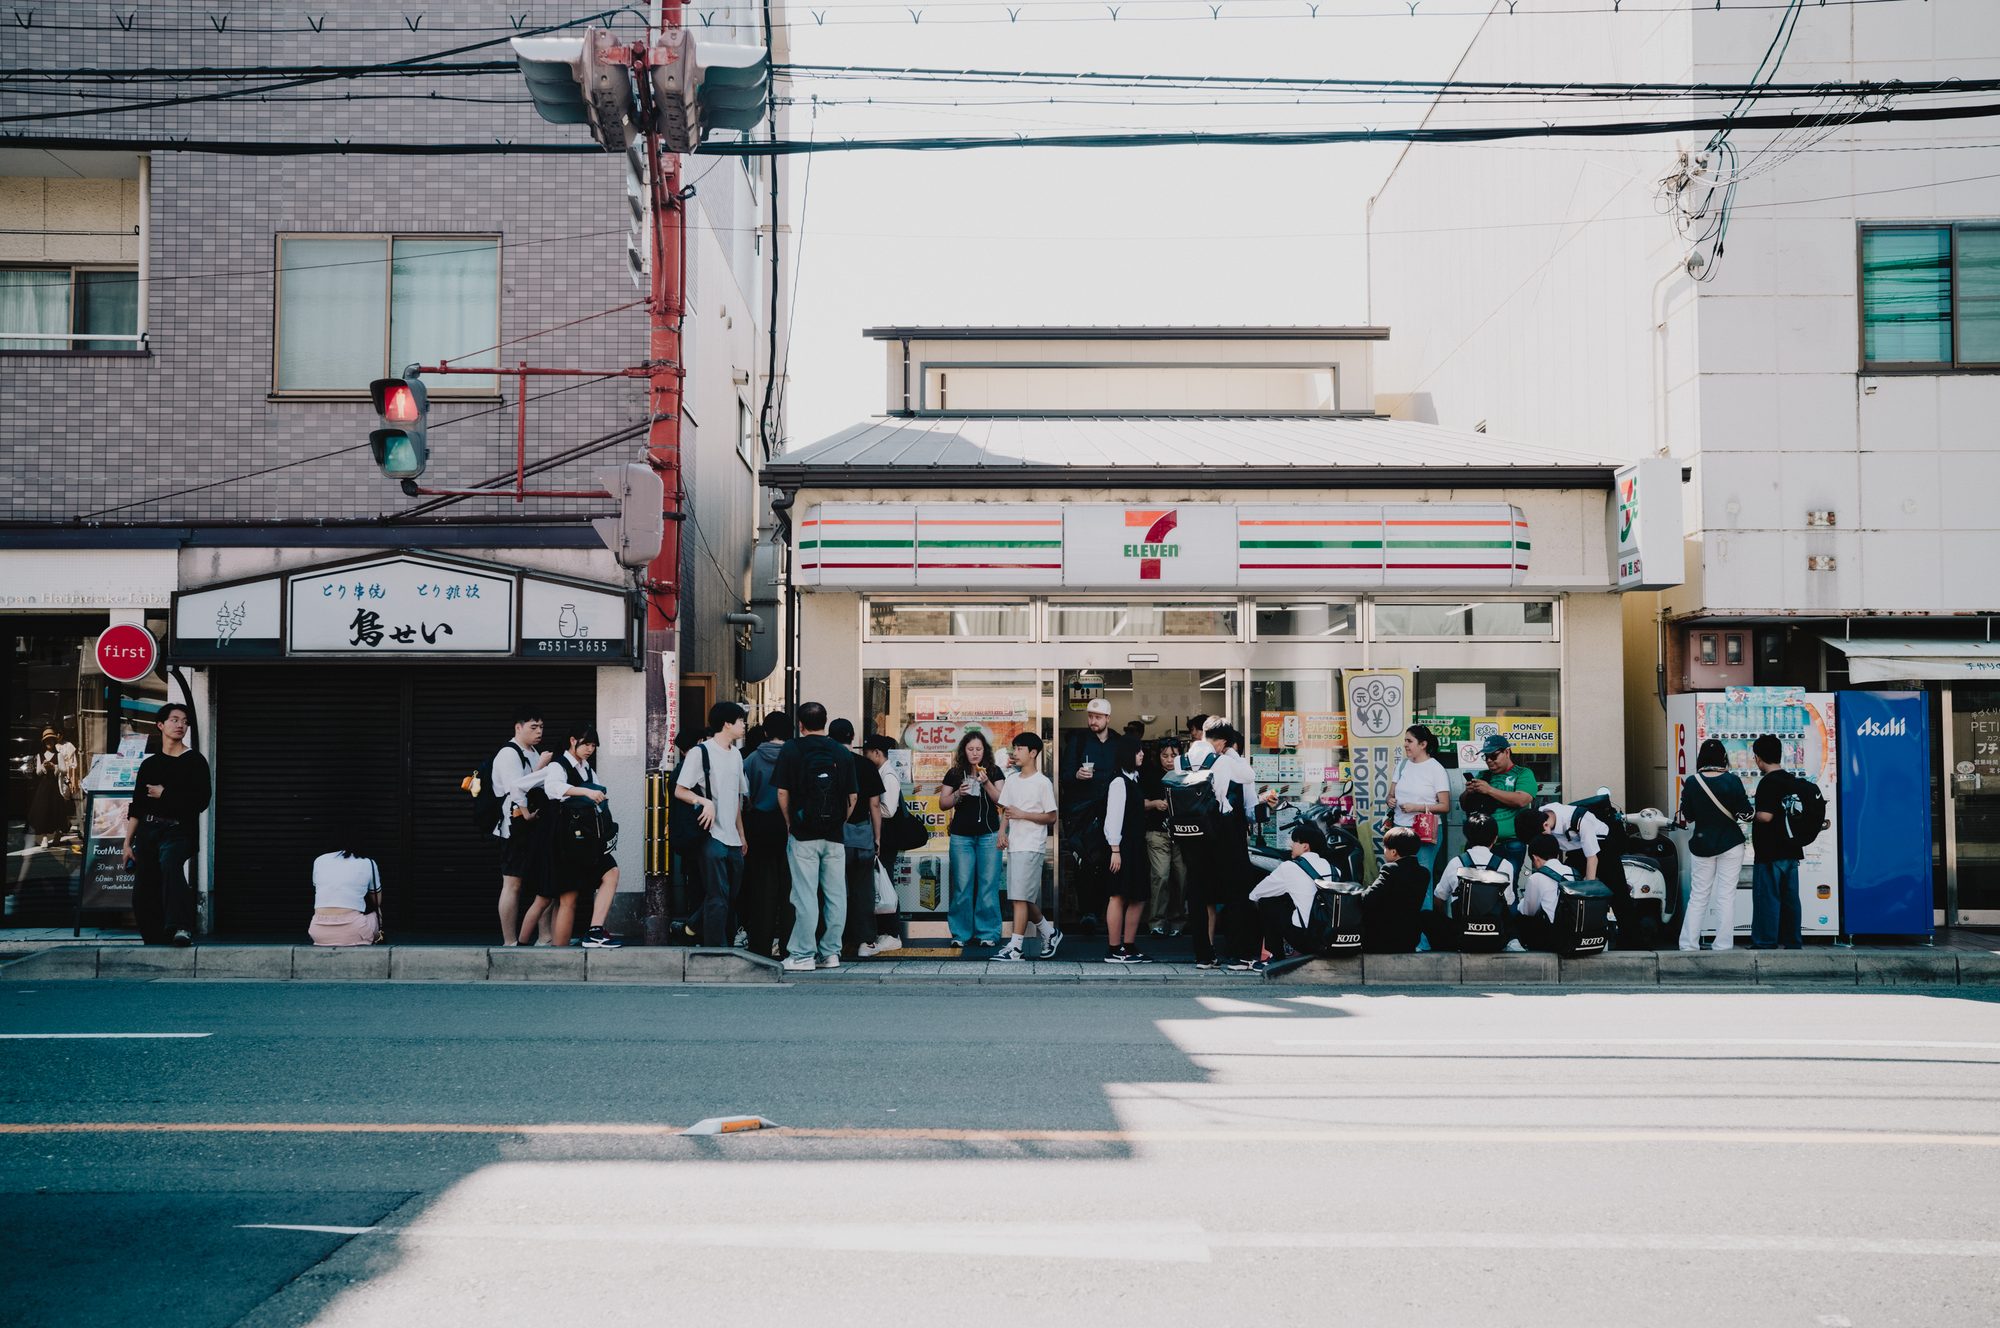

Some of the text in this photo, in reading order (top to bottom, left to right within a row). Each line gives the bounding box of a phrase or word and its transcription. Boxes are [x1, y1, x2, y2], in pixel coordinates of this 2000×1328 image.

[349, 608, 453, 647] 鳥せい
[104, 644, 146, 659] first
[1513, 723, 1543, 731] MONEY
[1857, 717, 1905, 736] Asahi
[916, 726, 956, 744] たばこ
[1503, 732, 1554, 741] EXCHANGE
[1976, 743, 1998, 754] プチ
[1325, 771, 1339, 779] SIM
[905, 801, 928, 811] NEY
[1174, 824, 1200, 833] KOTO
[1468, 923, 1496, 932] KOTO
[1336, 934, 1360, 943] KOTO
[1580, 936, 1604, 947] KOTO
